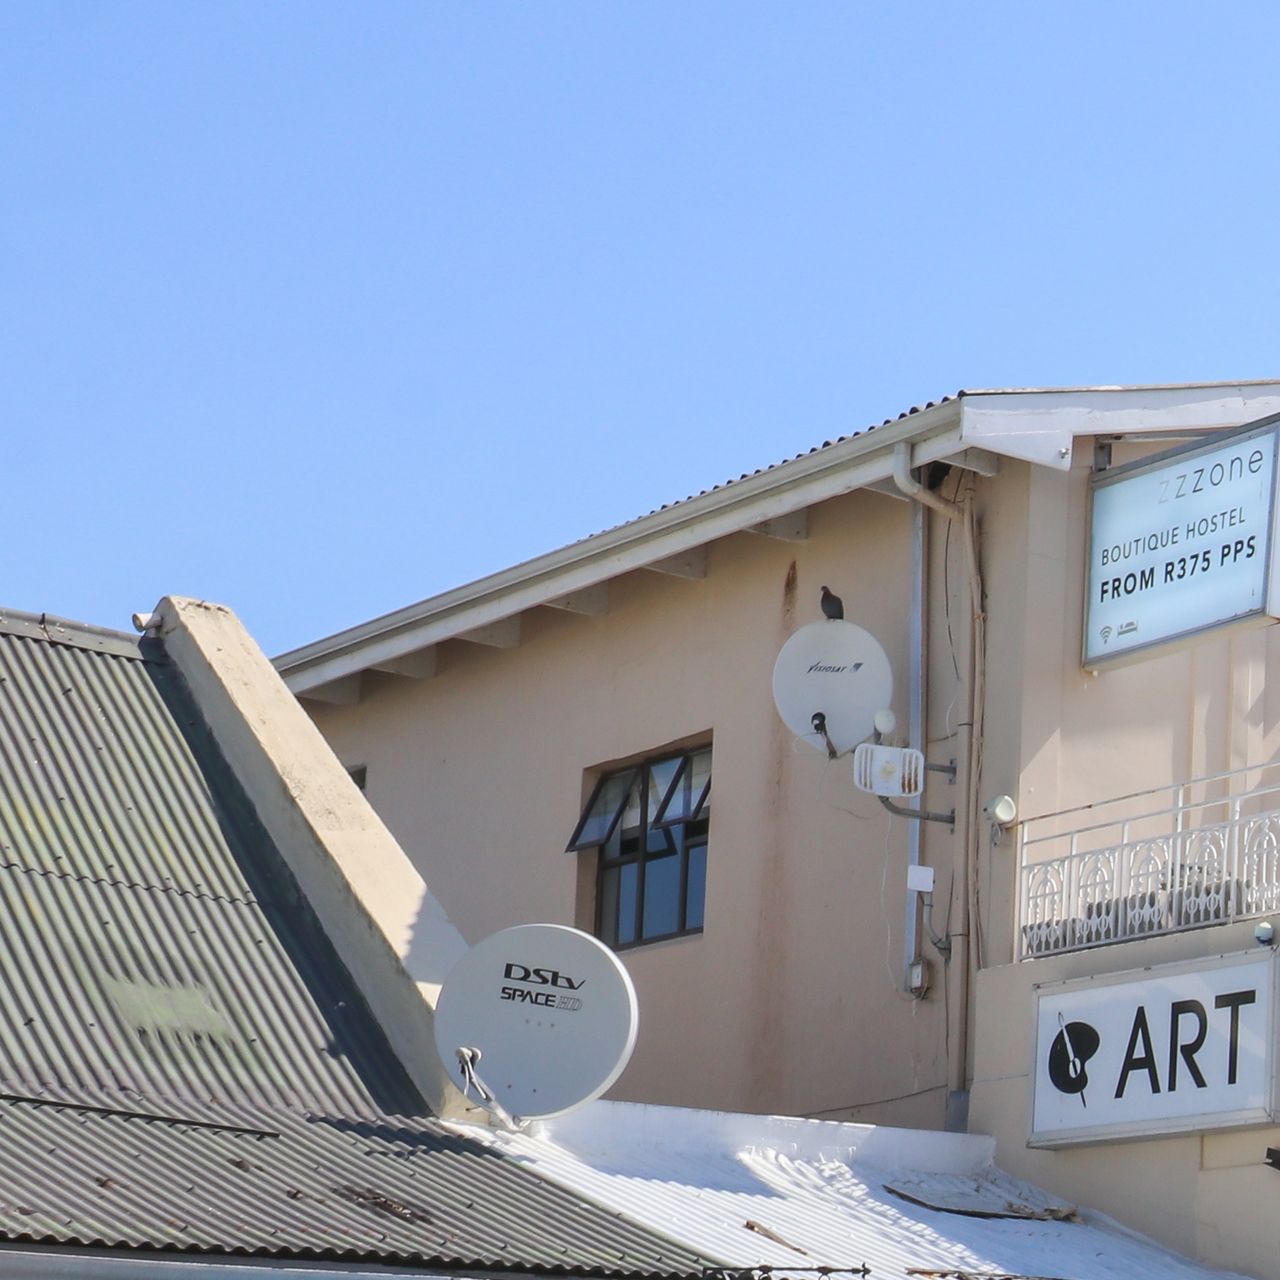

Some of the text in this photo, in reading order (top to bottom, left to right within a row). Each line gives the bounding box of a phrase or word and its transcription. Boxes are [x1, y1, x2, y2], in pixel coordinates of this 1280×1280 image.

[1101, 506, 1246, 567] BOUTIQUE HOSTEL
[1100, 535, 1257, 603] FROM R375 PPS
[500, 986, 556, 1008] SPACE
[1113, 989, 1257, 1100] ART
